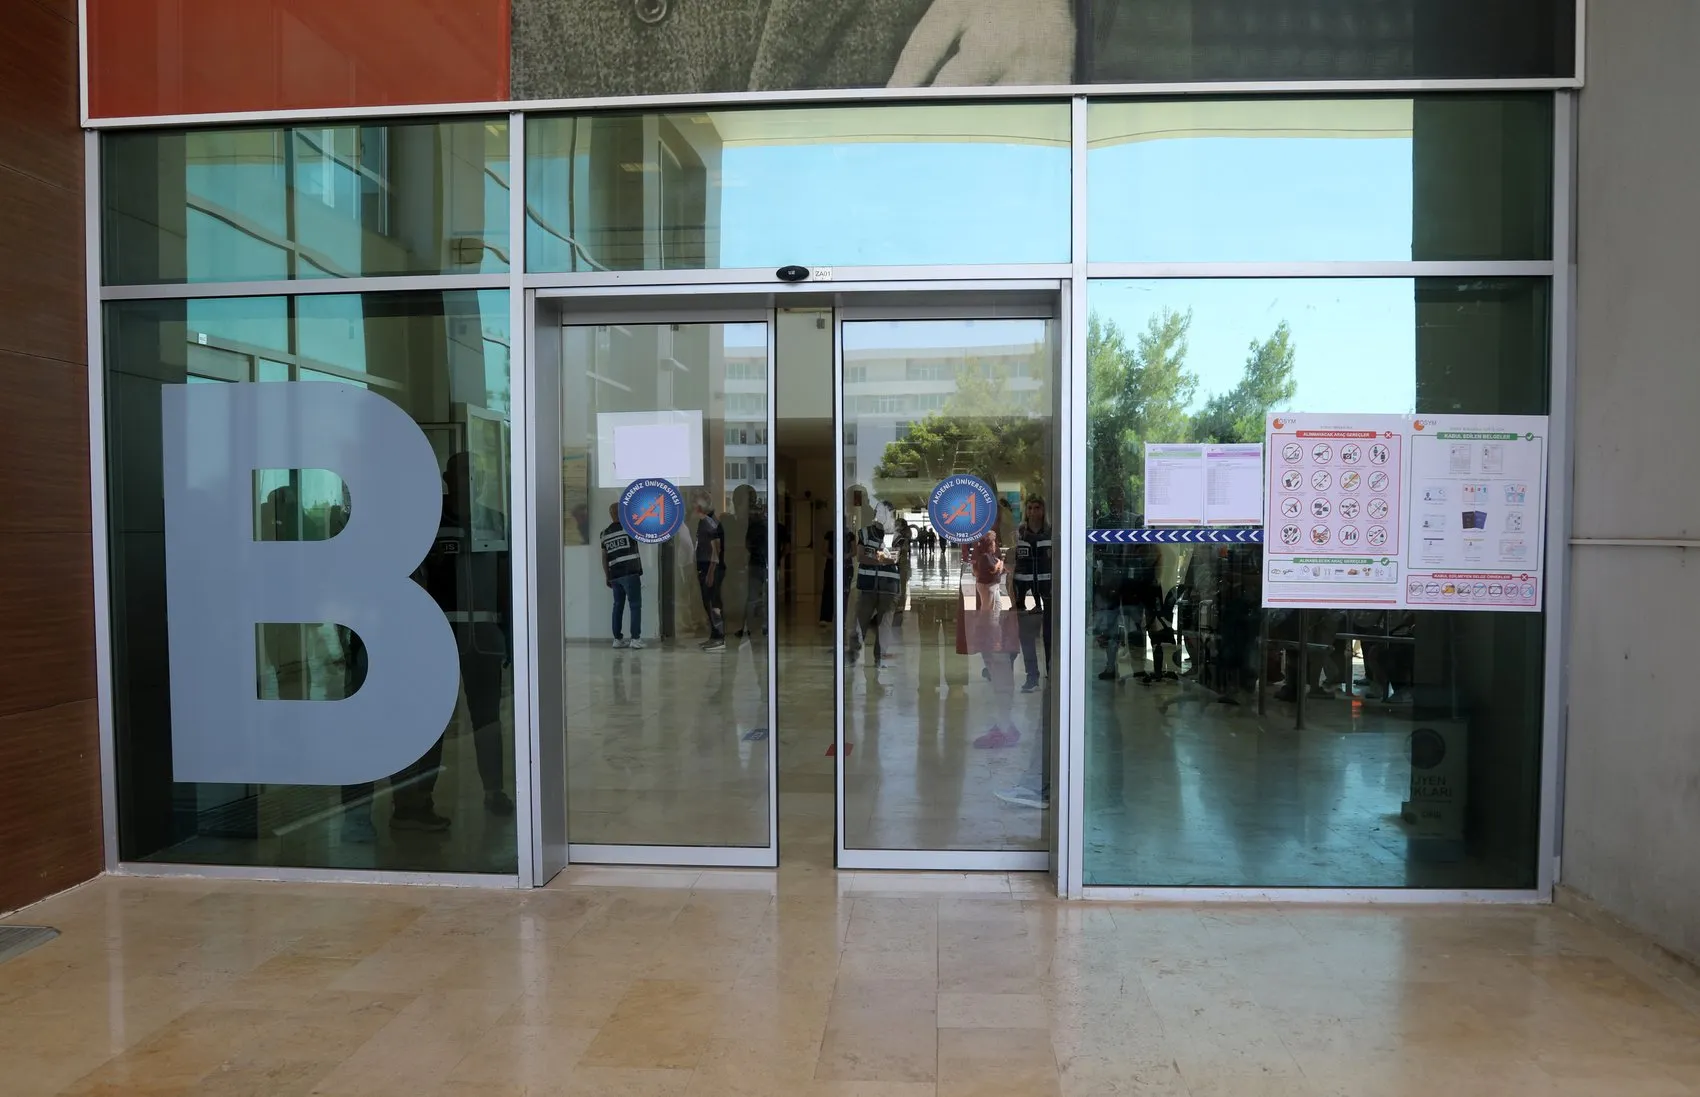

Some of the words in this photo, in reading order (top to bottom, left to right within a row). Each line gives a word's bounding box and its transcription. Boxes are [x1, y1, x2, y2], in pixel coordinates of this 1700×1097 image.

[623, 482, 645, 506] AKDENİZ
[645, 480, 681, 505] ÜNİVERSİTESİ
[933, 481, 955, 504] AKDENİZ
[955, 478, 993, 504] ÜNİVERSİTESİ
[161, 380, 460, 786] B
